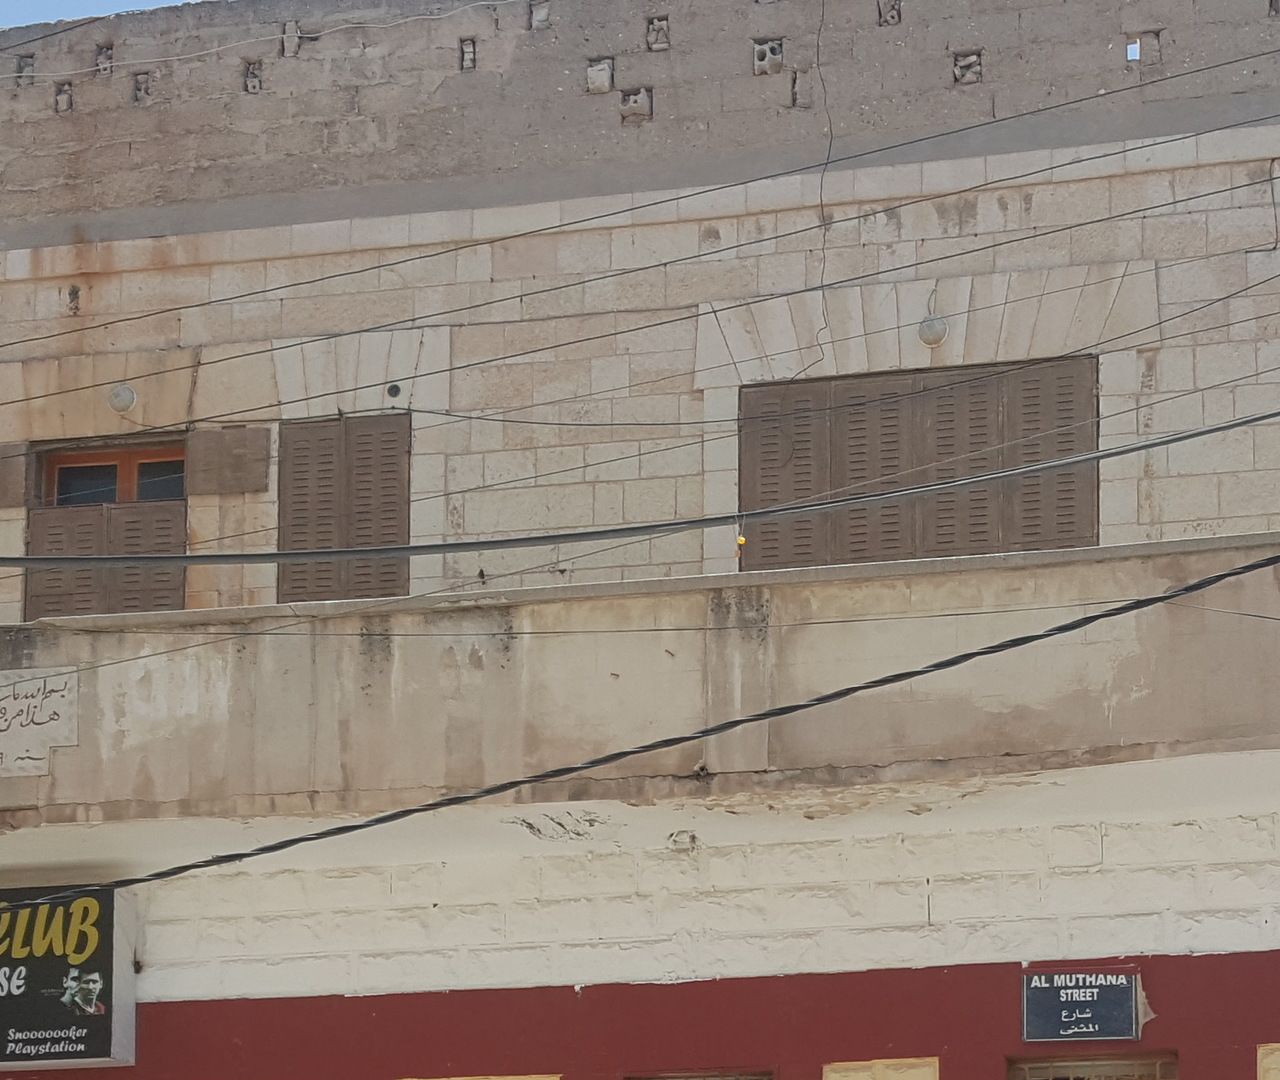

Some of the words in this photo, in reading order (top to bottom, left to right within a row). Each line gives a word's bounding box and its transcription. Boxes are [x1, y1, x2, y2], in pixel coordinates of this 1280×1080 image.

[1030, 975, 1050, 988] AL
[1053, 974, 1128, 987] MUTHANA
[1059, 988, 1100, 1002] STREET
[1061, 1008, 1092, 1021] شارع
[6, 1040, 86, 1057] Playstation
